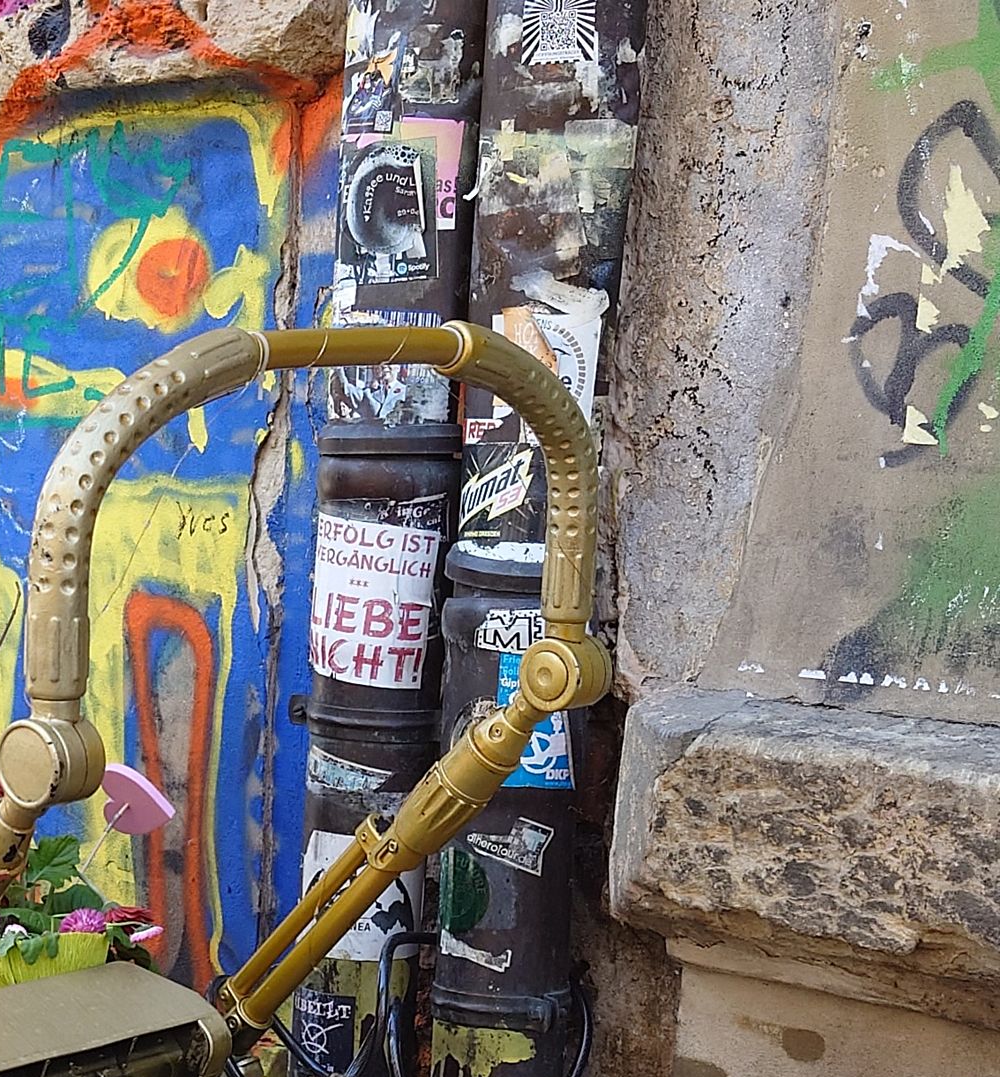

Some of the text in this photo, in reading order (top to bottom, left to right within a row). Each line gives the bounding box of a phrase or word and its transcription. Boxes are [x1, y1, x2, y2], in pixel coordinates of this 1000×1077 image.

[385, 172, 408, 187] und
[402, 533, 436, 555] IST
[312, 588, 424, 641] LIEBE
[311, 630, 422, 683] NICHT!
